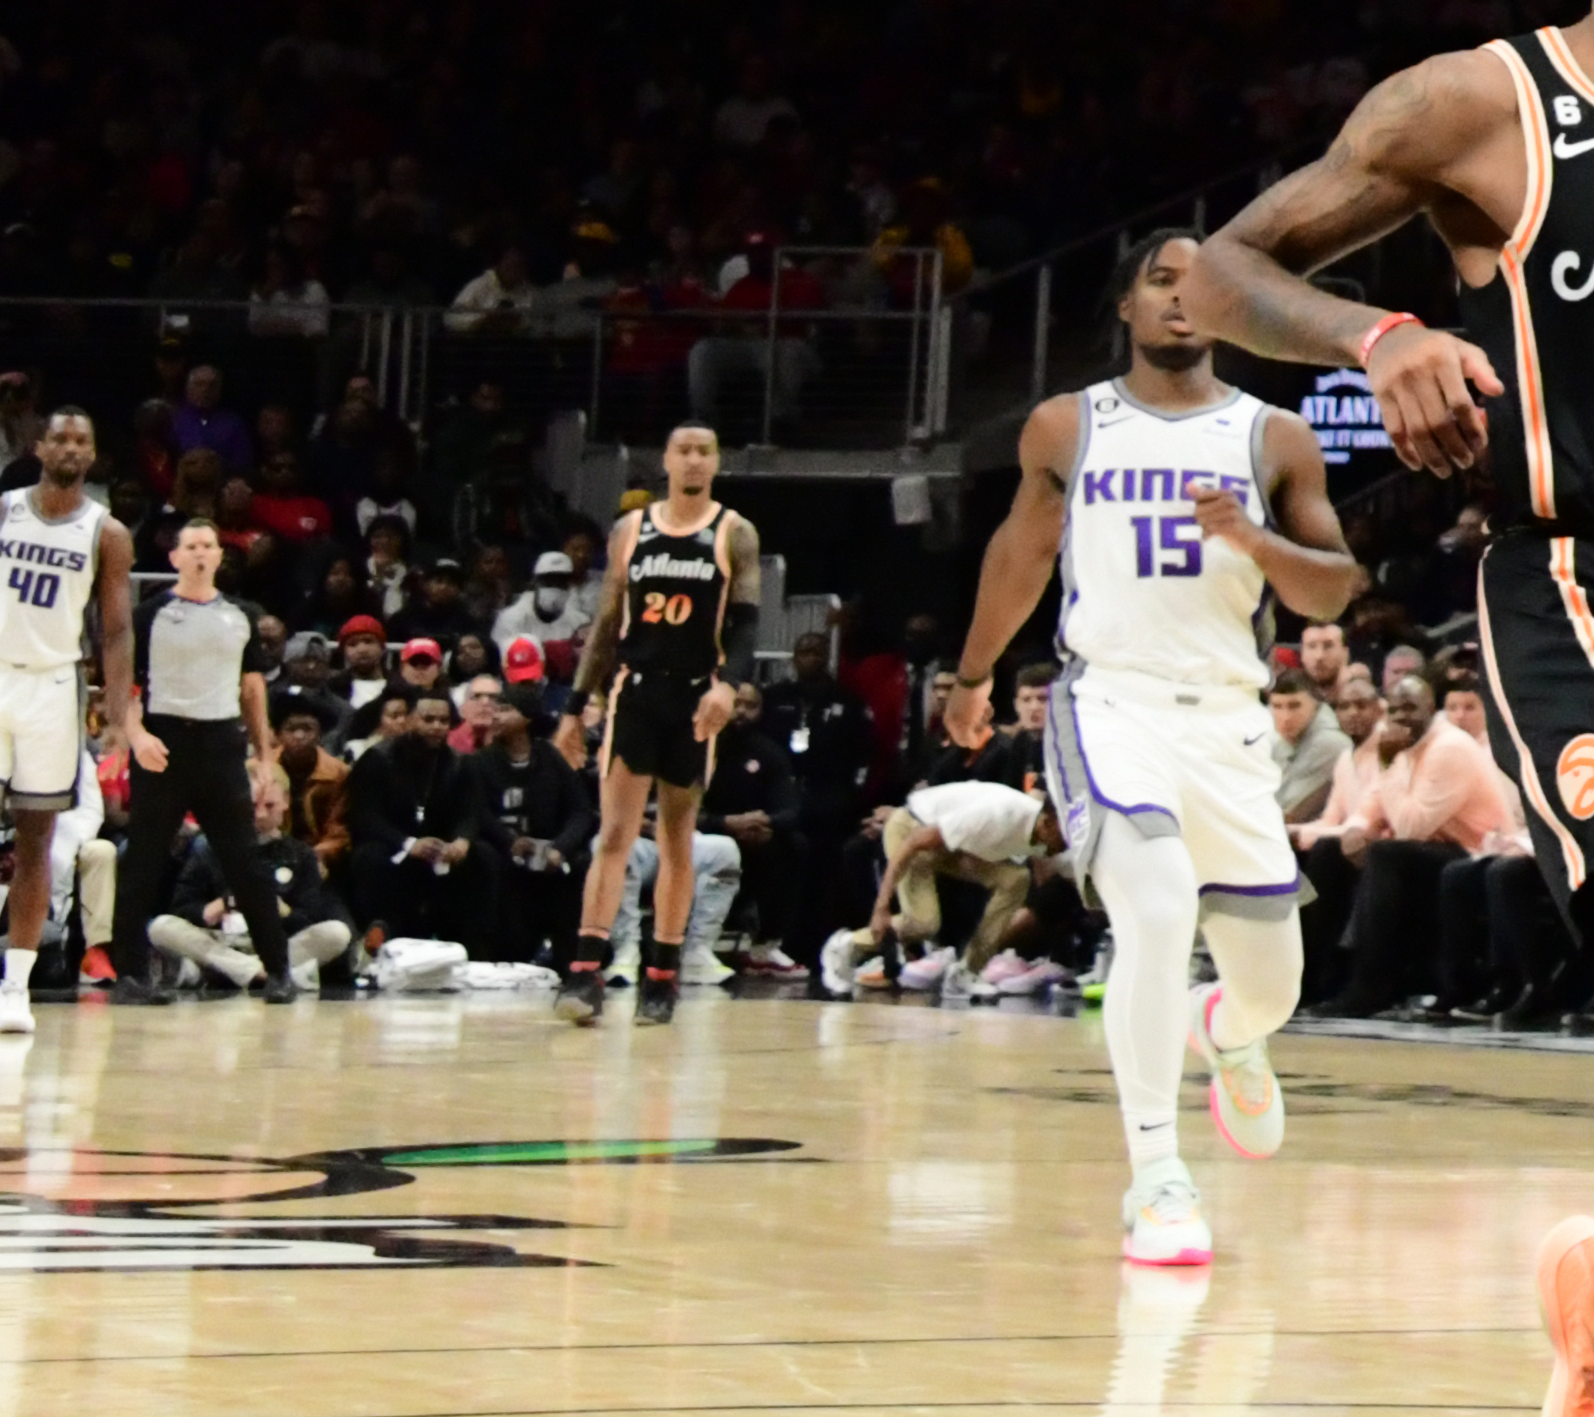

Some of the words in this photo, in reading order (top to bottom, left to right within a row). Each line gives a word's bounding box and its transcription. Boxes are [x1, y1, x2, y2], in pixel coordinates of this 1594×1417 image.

[1553, 95, 1581, 126] 6
[0, 539, 87, 573] KINGS
[1131, 516, 1204, 578] 15
[630, 552, 716, 582] Atlanta
[8, 567, 60, 609] 40
[642, 592, 694, 626] 20
